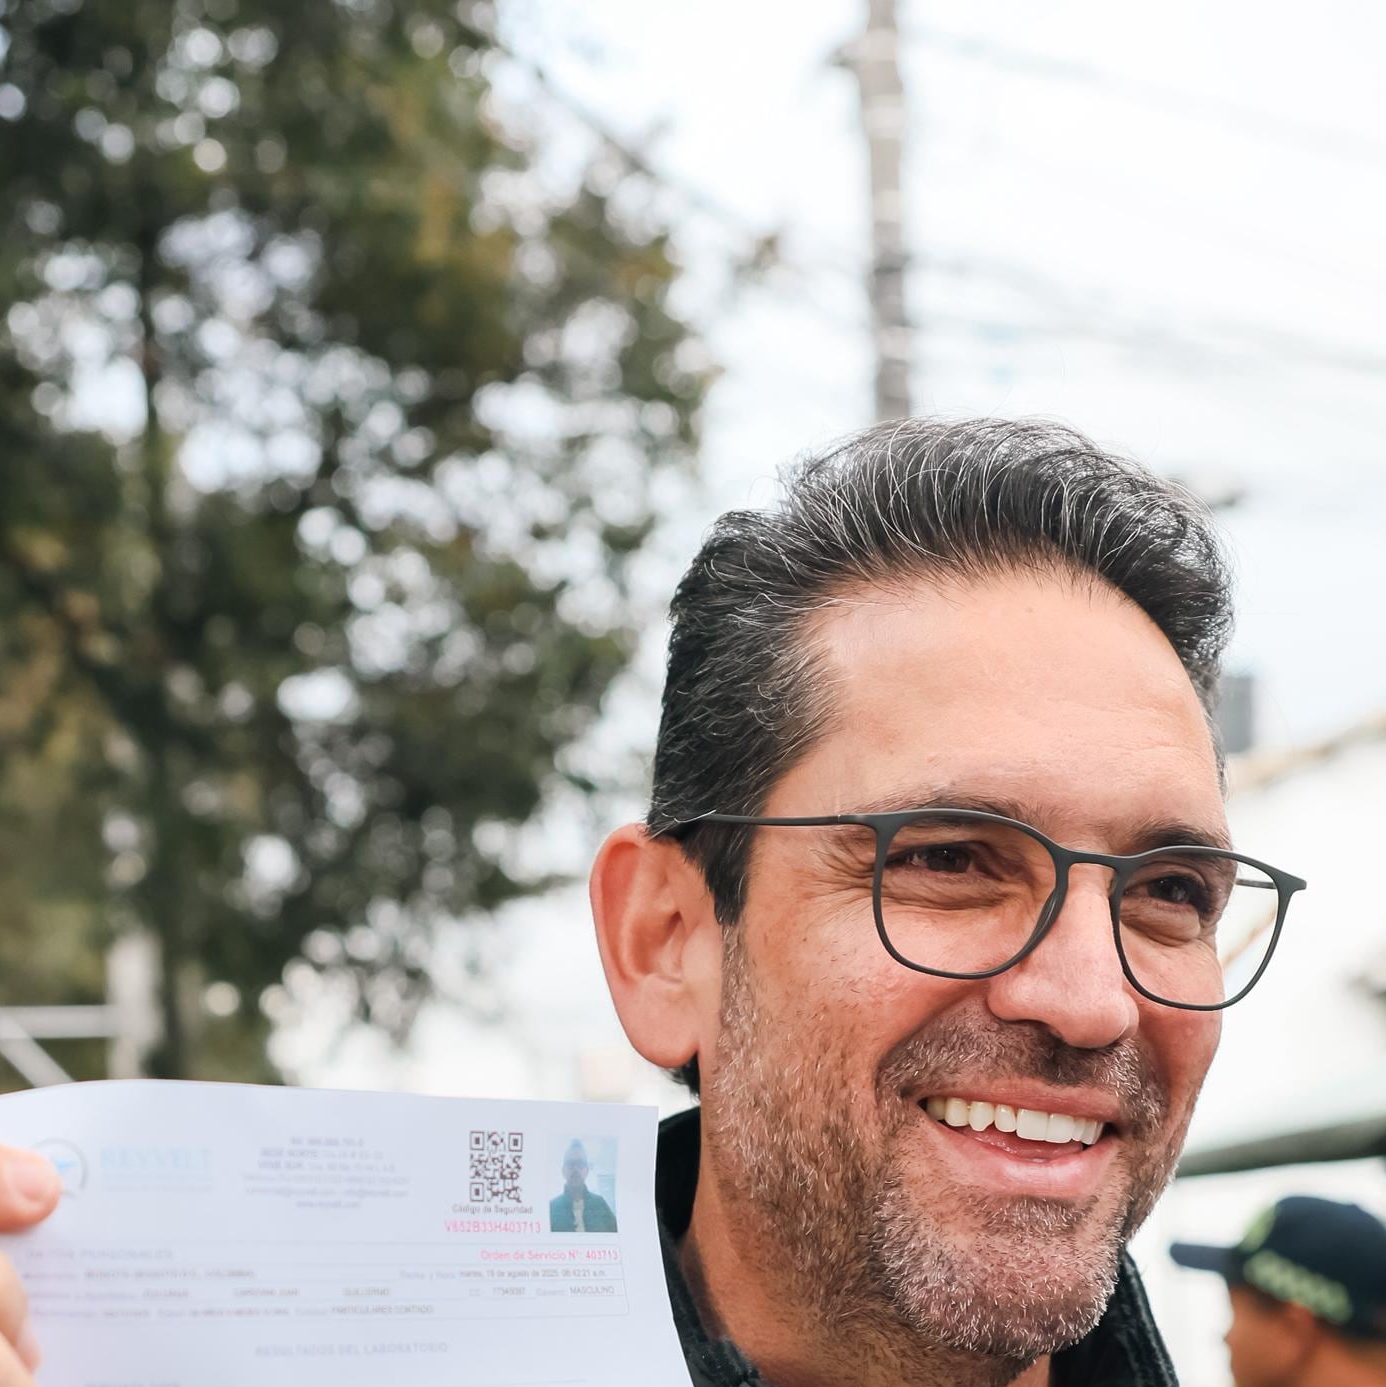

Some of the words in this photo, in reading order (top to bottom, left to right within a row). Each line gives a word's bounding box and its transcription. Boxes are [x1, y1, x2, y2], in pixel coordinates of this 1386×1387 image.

[480, 1250, 510, 1260] Orden
[513, 1250, 524, 1260] de
[528, 1250, 566, 1260] Servicio
[586, 1250, 618, 1260] 403713
